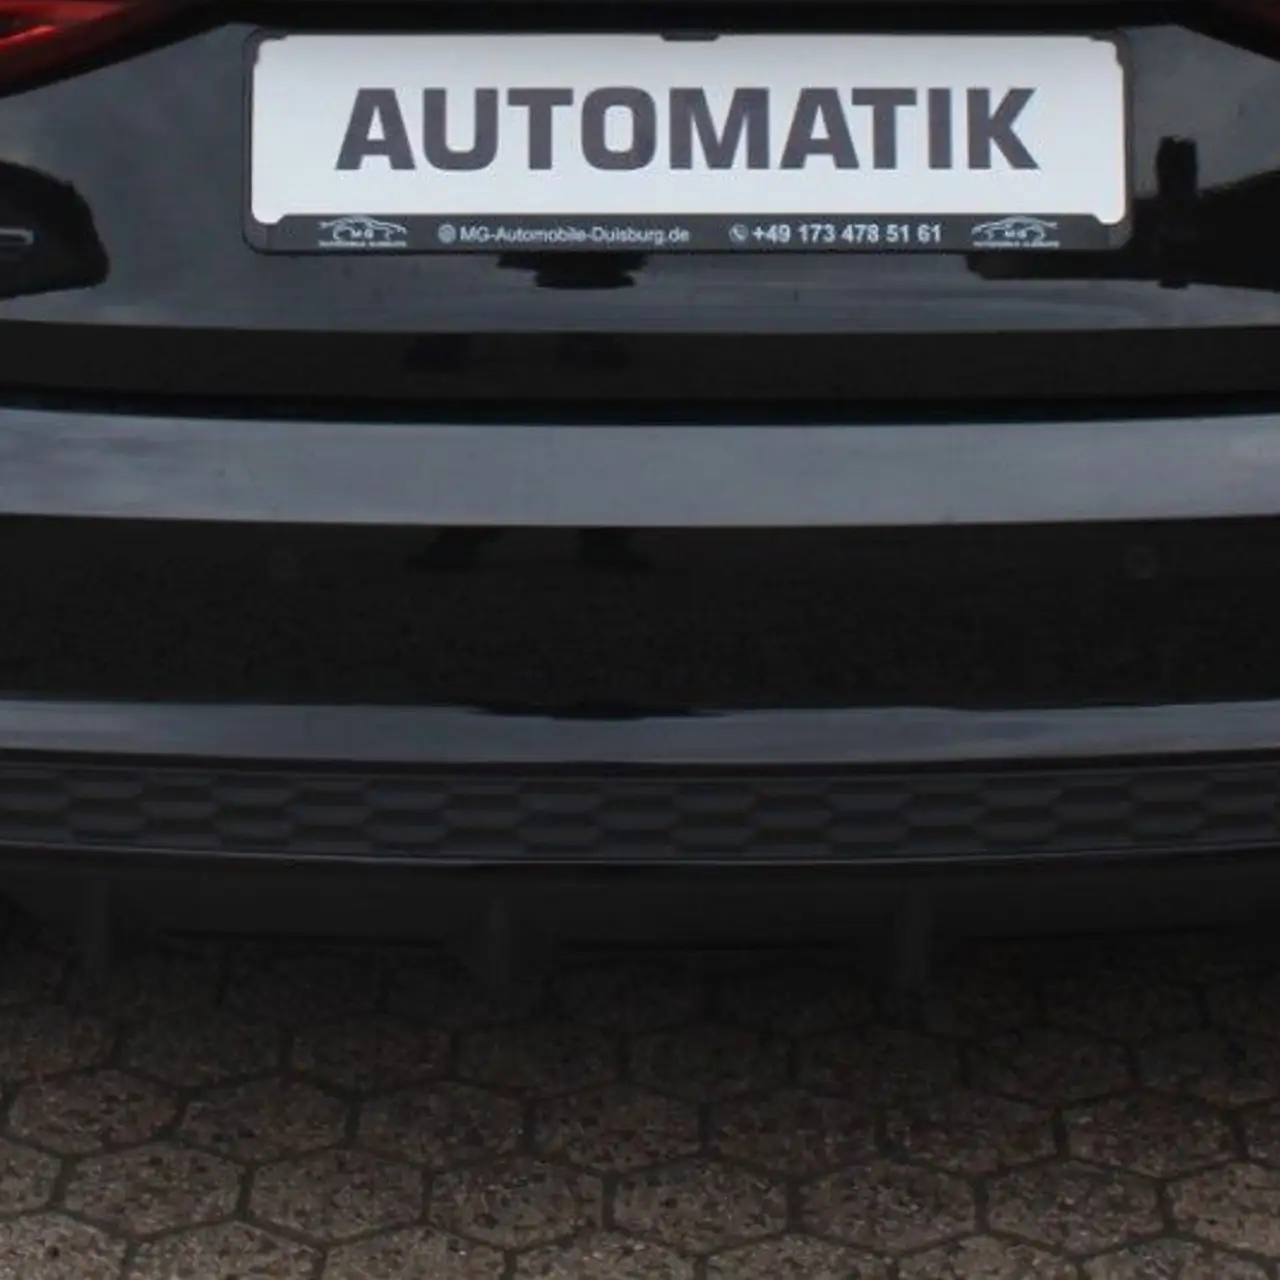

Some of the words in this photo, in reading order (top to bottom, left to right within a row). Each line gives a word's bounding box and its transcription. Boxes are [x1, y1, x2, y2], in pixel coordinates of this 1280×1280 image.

[335, 86, 1040, 171] AUTOMATIK
[459, 224, 690, 246] MG-Automobile-Duisburg.de
[751, 223, 792, 244] +49
[798, 223, 837, 244] 173
[840, 223, 880, 244] 478
[885, 223, 910, 244] 51
[916, 223, 942, 244] 61
